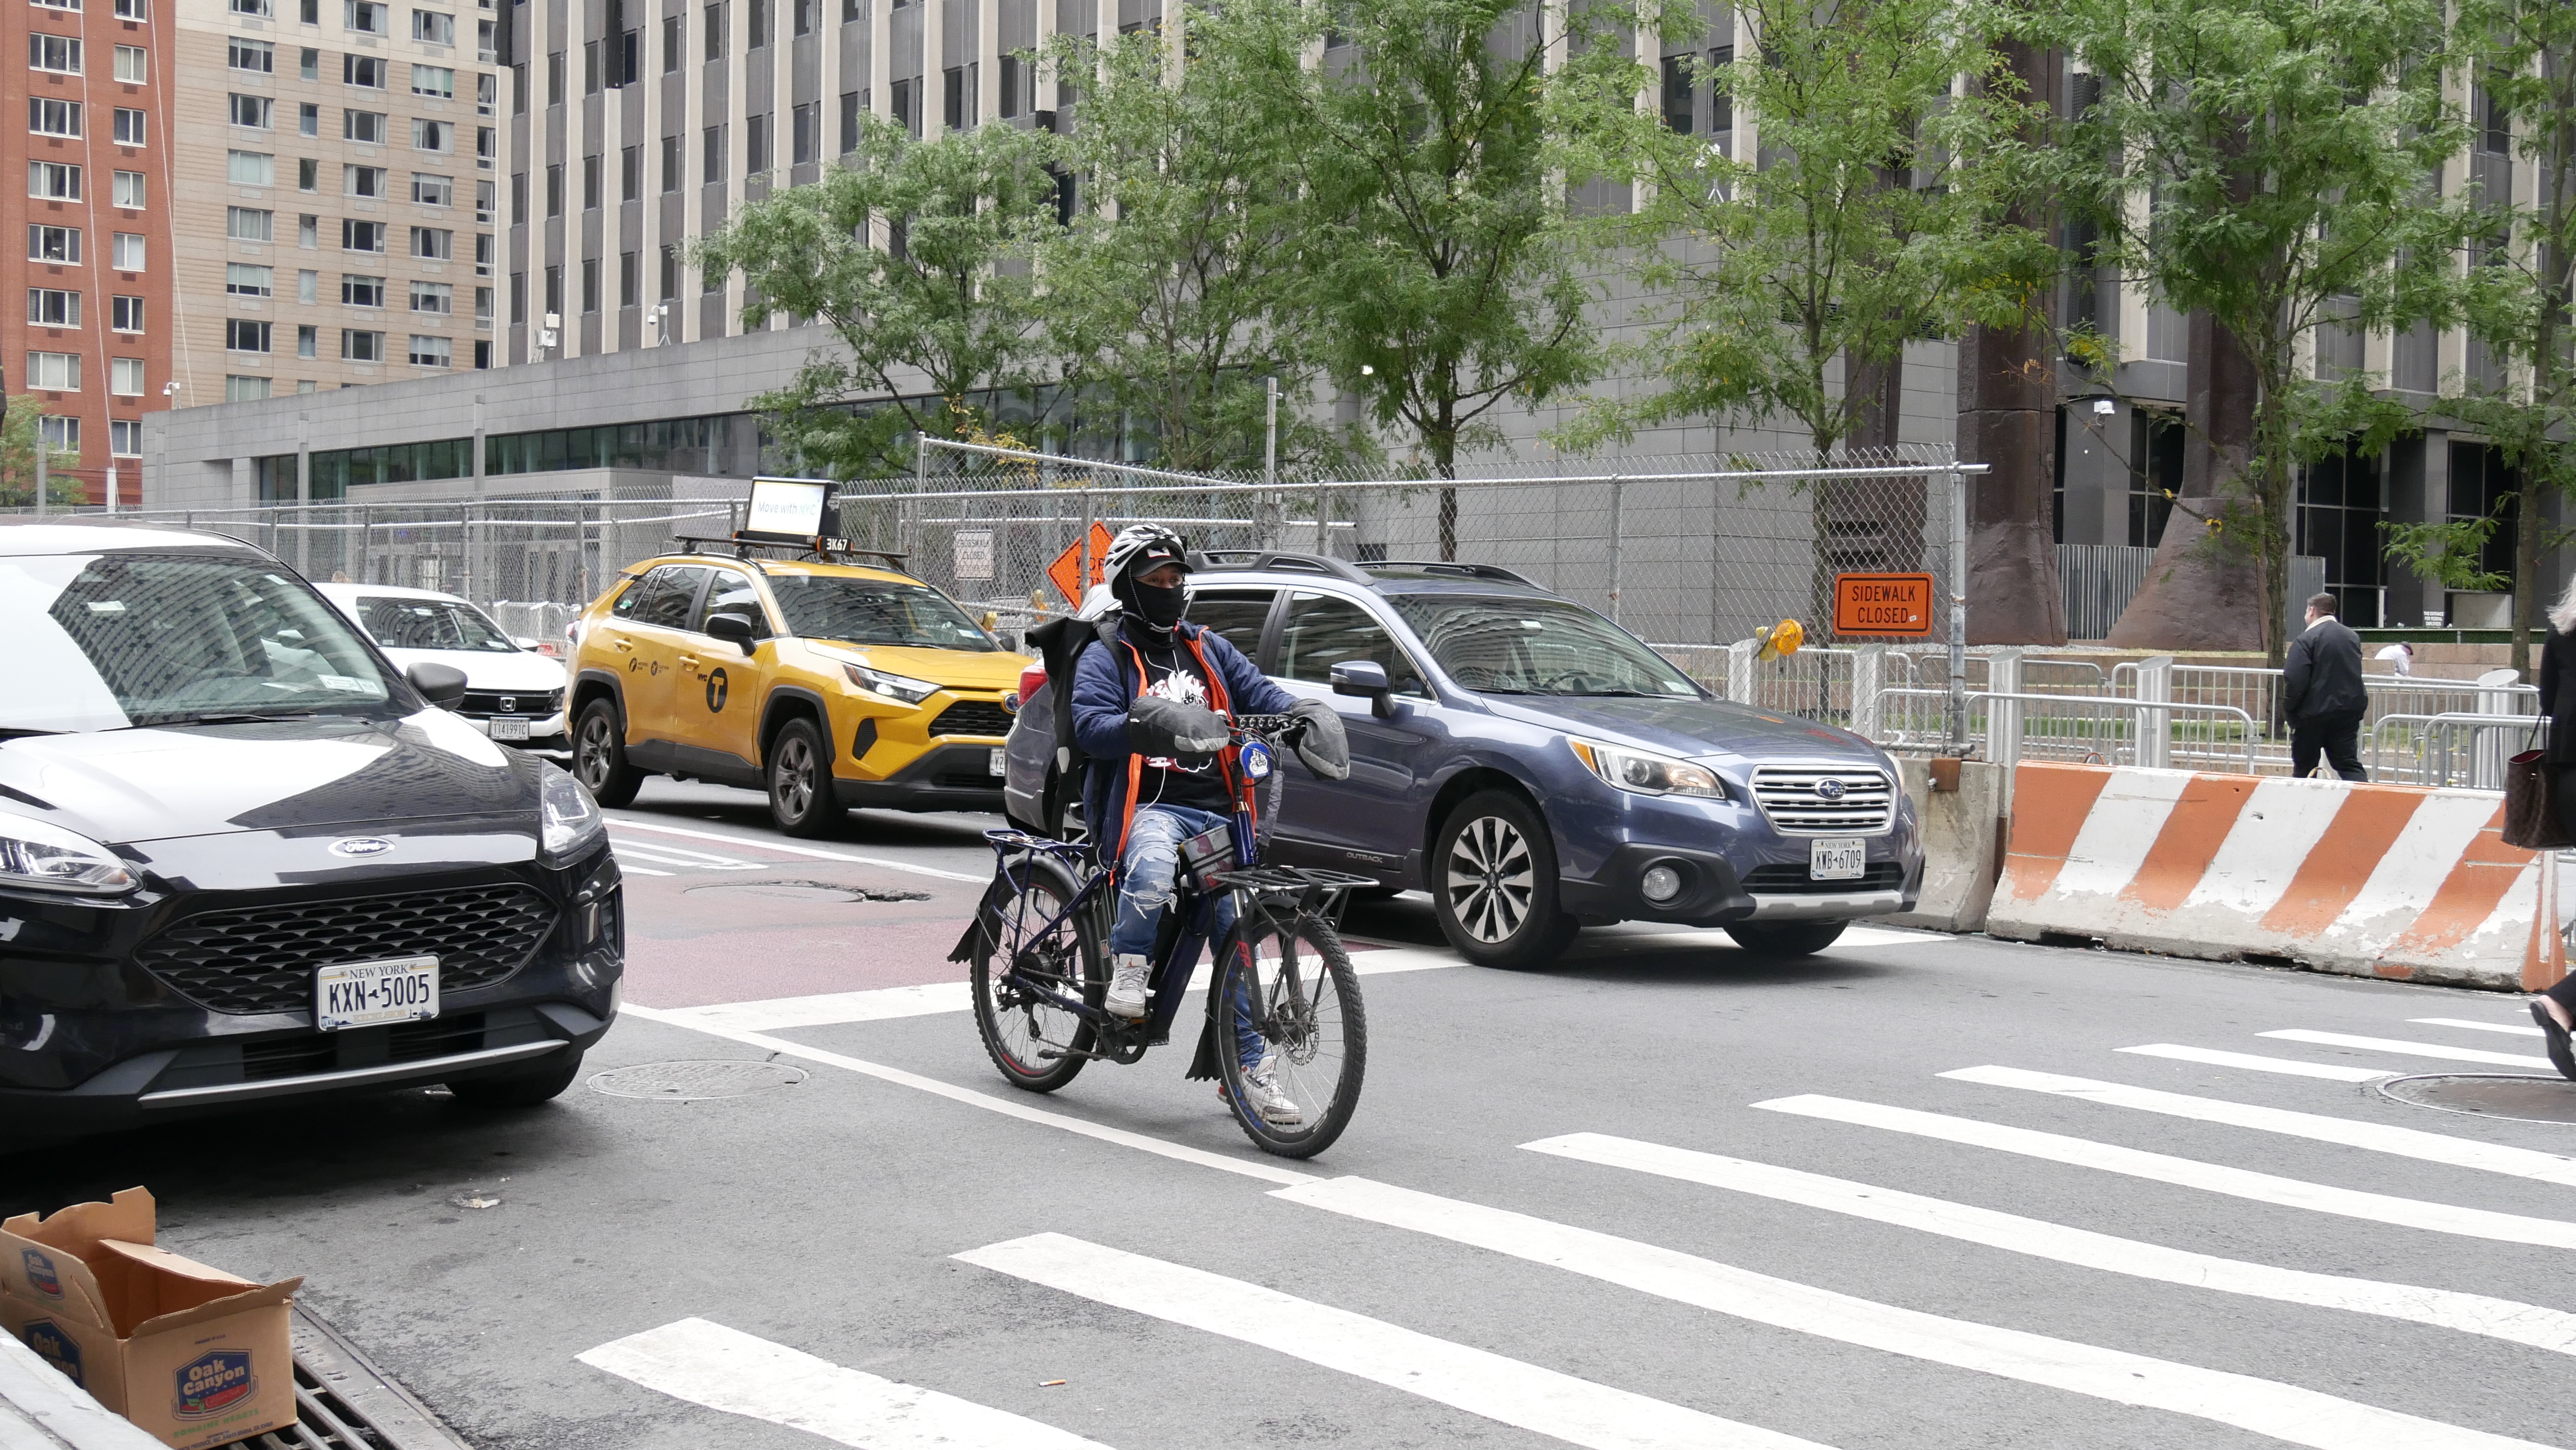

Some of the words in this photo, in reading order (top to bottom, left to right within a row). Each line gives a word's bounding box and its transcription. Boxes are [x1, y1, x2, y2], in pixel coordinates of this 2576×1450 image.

[758, 502, 779, 513] Move
[780, 502, 797, 515] with
[799, 503, 816, 516] NYC
[826, 538, 848, 551] 3K67
[1851, 585, 1916, 602] SIDEWALK
[1857, 607, 1908, 623] CLOSED
[697, 673, 708, 682] NYC
[712, 676, 725, 707] T
[494, 724, 526, 735] T141991C
[344, 839, 381, 853] Ford
[1346, 852, 1383, 863] OUTBACK
[349, 967, 376, 979] NEW
[378, 963, 409, 976] YORK
[33, 1332, 62, 1357] Oak
[189, 1359, 226, 1381] Oak
[183, 1366, 245, 1395] Canyon
